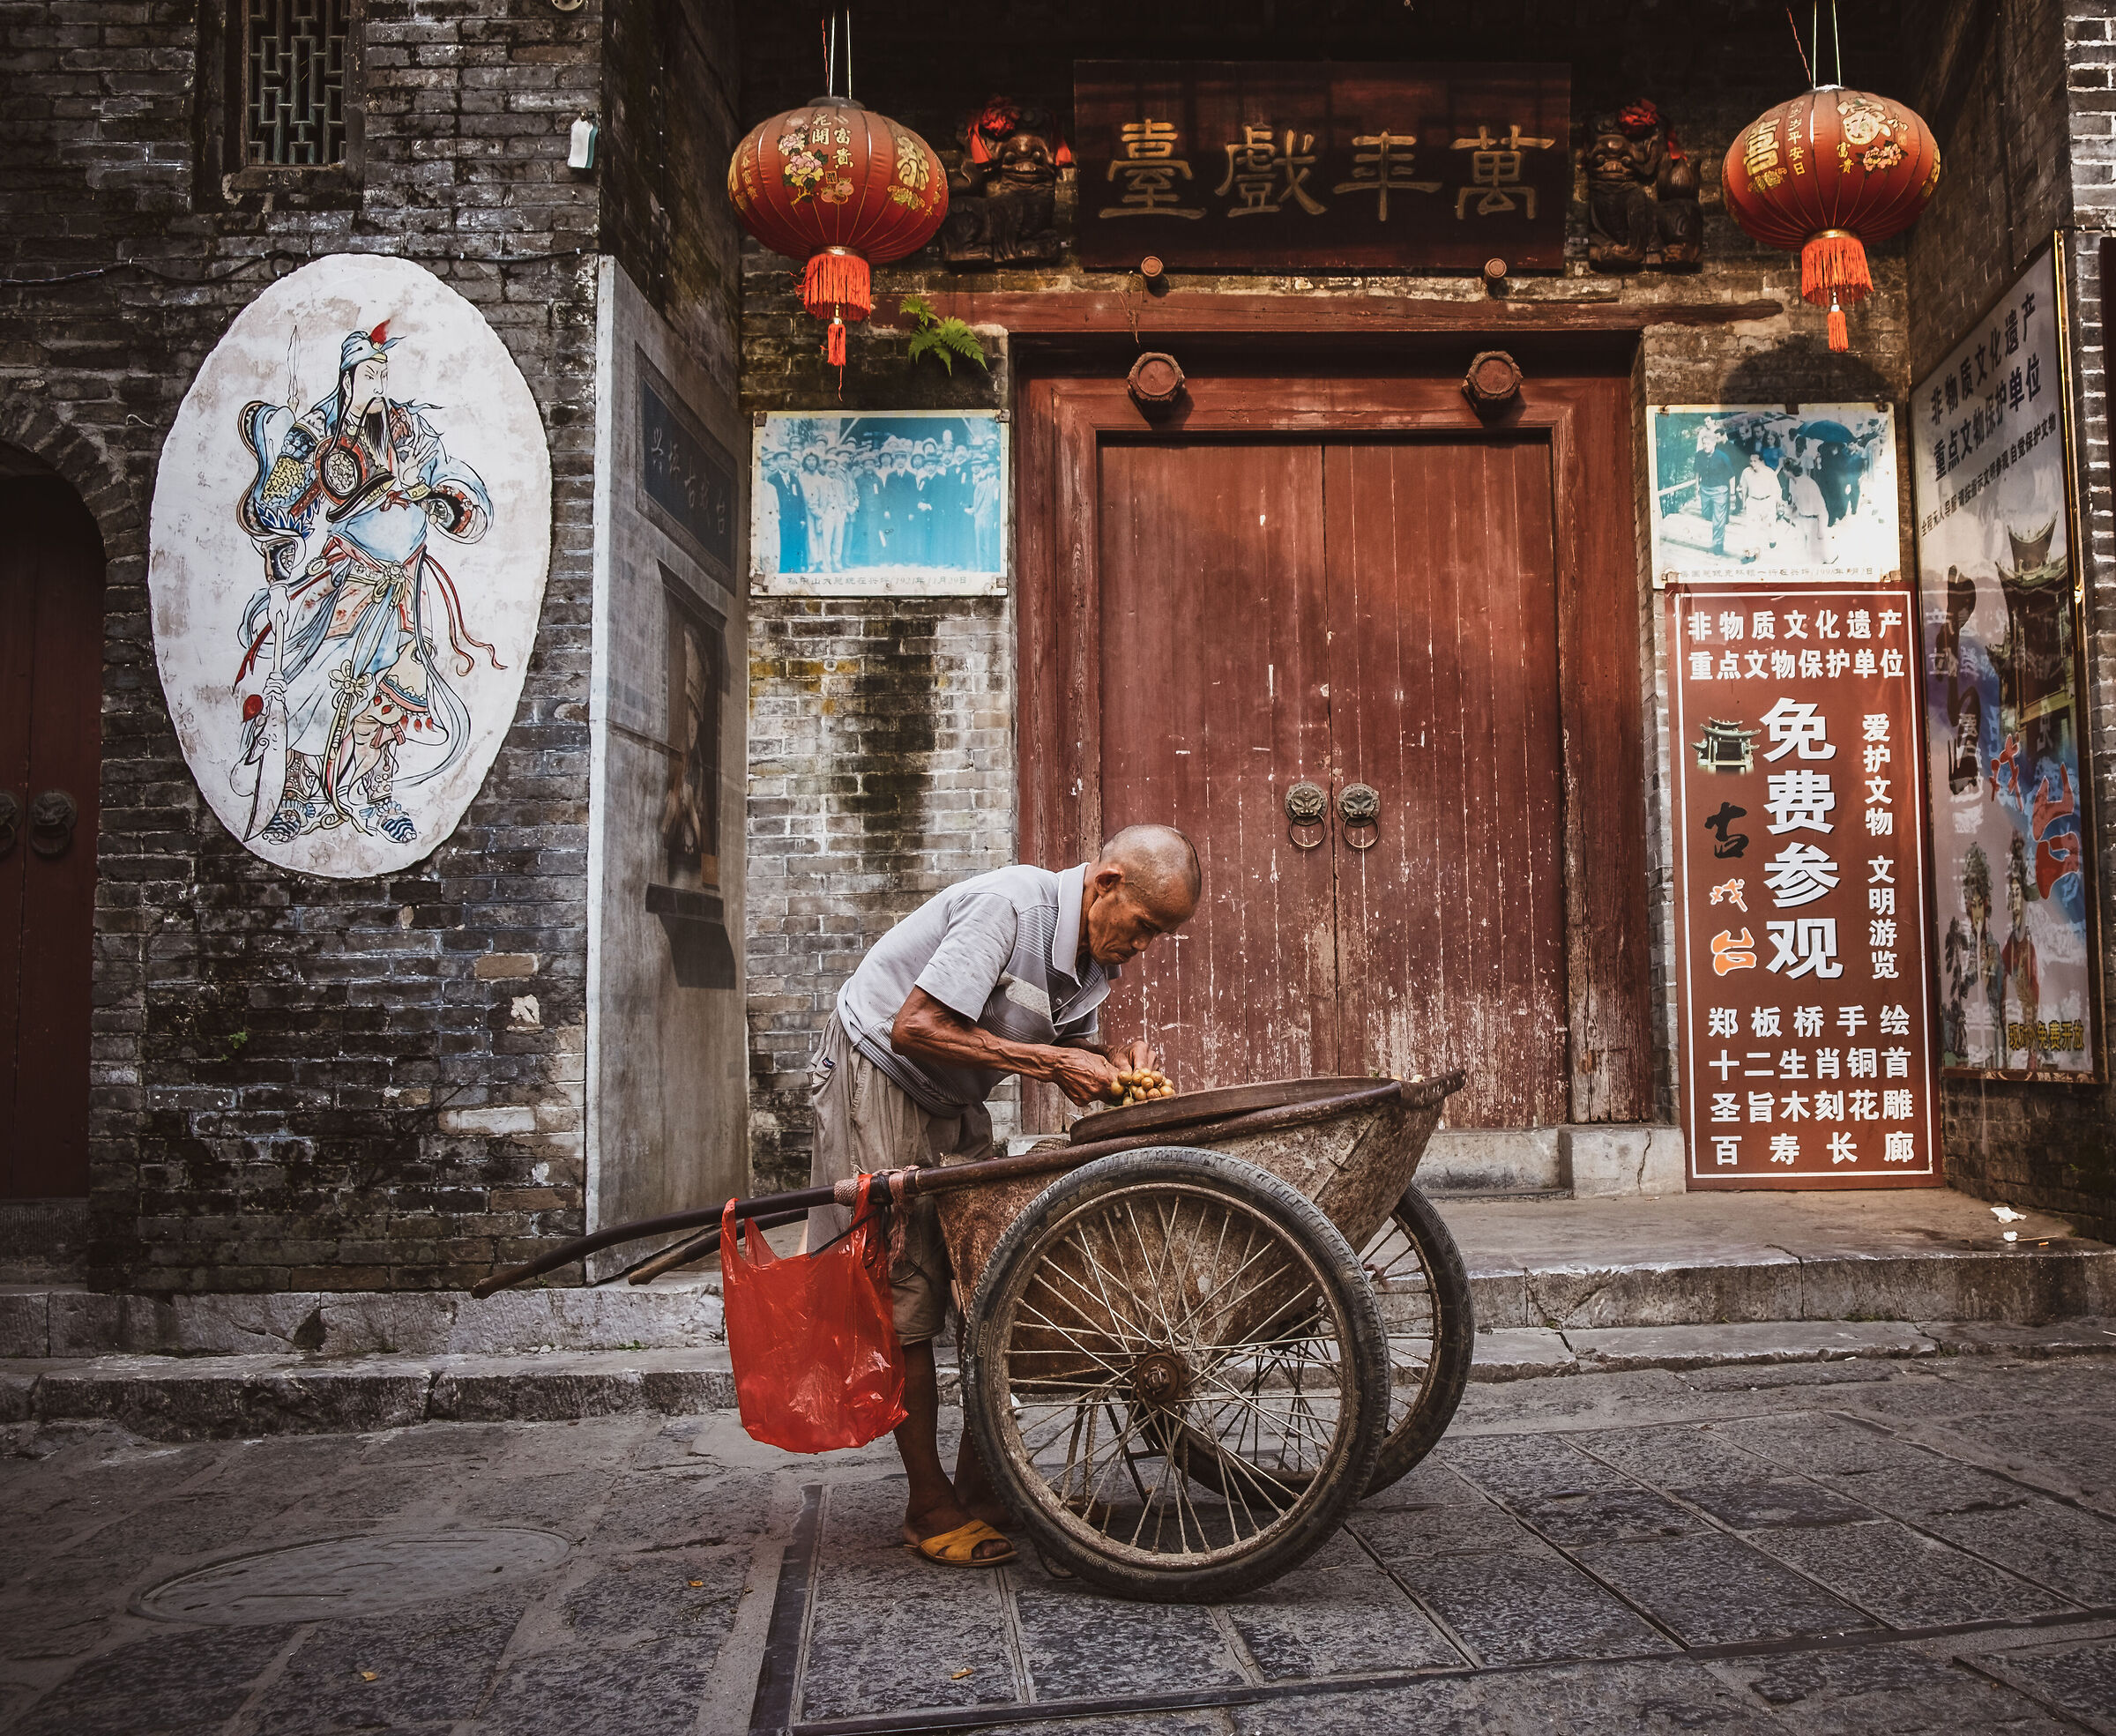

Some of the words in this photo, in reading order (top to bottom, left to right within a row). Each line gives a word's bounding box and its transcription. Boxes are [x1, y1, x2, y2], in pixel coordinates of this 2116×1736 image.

[1930, 292, 2037, 426] 非物质文化遗产
[1933, 353, 2042, 482] 重点文物保护单位
[1688, 608, 1903, 642] 非物质文化遗产
[1688, 647, 1905, 681] 重点文物保护单位
[1861, 712, 1894, 838] 爱护文物
[1759, 696, 1845, 980] 免费参观
[1867, 855, 1900, 980] 文明游览
[1708, 1004, 1911, 1040] 郑板桥手绘
[1709, 1046, 1912, 1081] 十二生肖铜首
[1710, 1088, 1915, 1124] 圣旨木刻花雕
[1710, 1129, 1916, 1166] 百寿长廊
